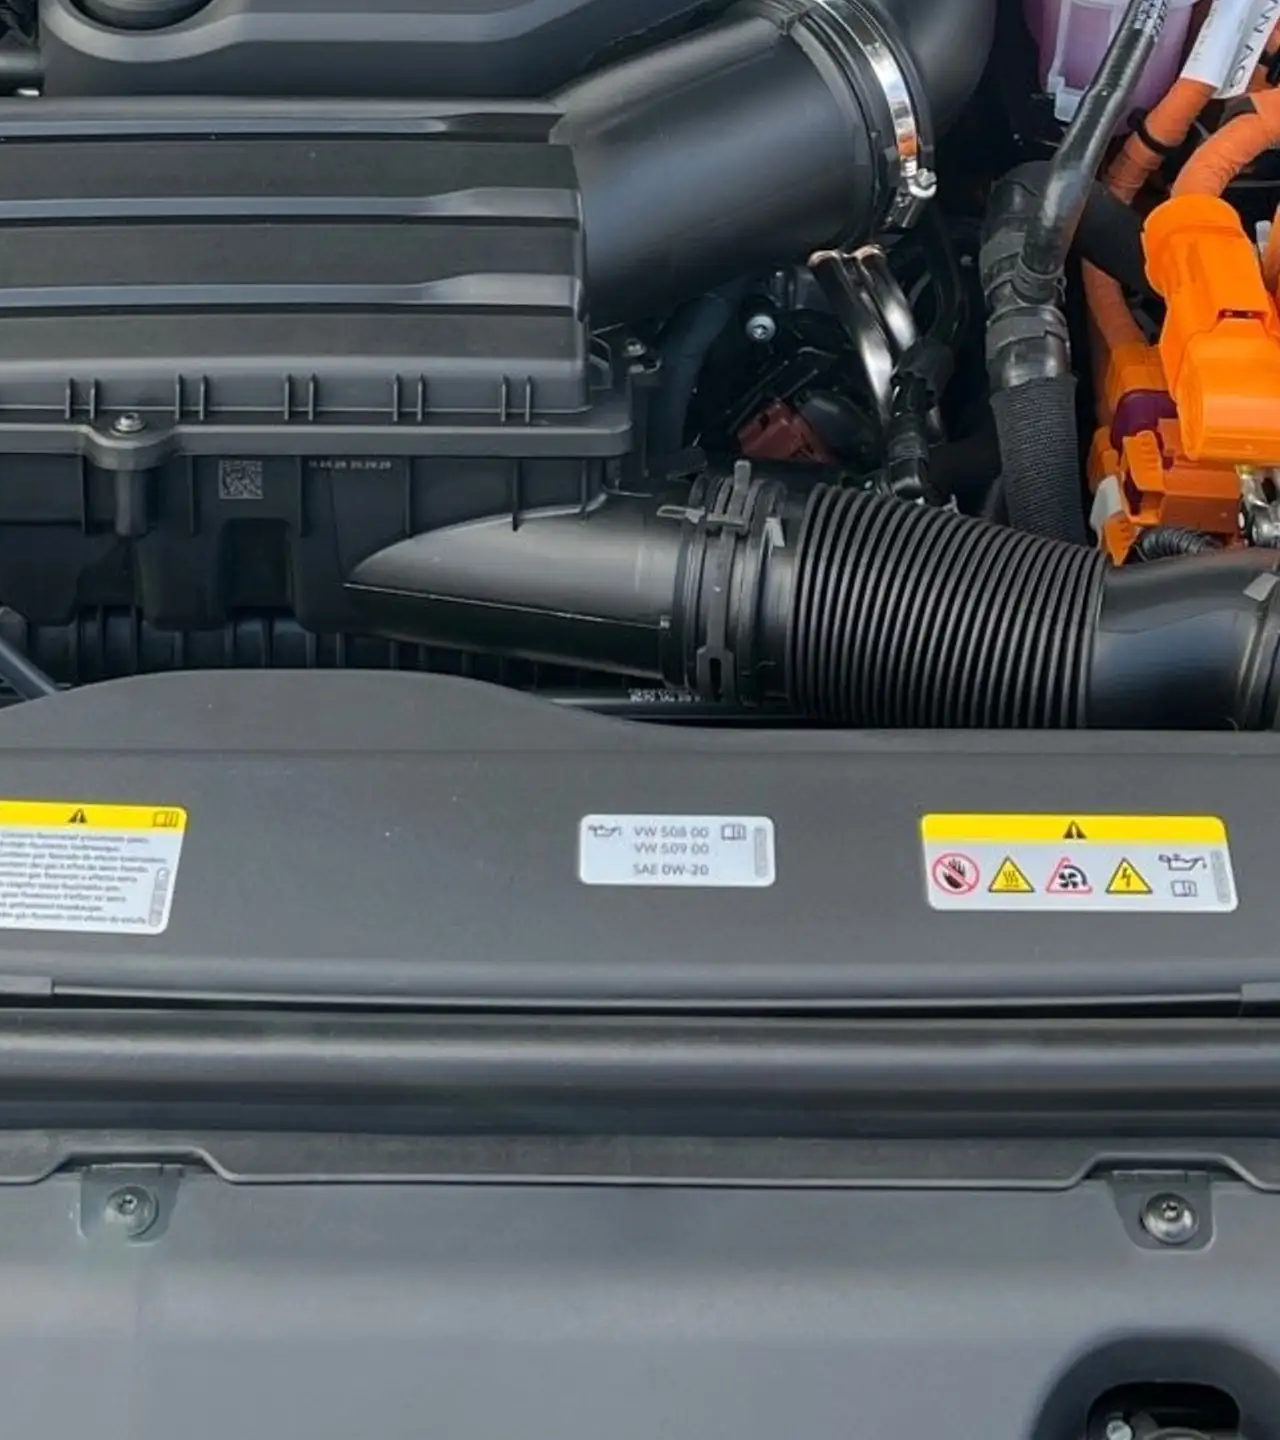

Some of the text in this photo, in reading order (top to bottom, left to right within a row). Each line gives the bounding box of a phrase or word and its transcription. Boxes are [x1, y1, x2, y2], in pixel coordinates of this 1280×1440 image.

[634, 826, 710, 838] VW 508 00
[634, 843, 710, 855] VW 509 00
[632, 863, 710, 876] SAE 0W-20
